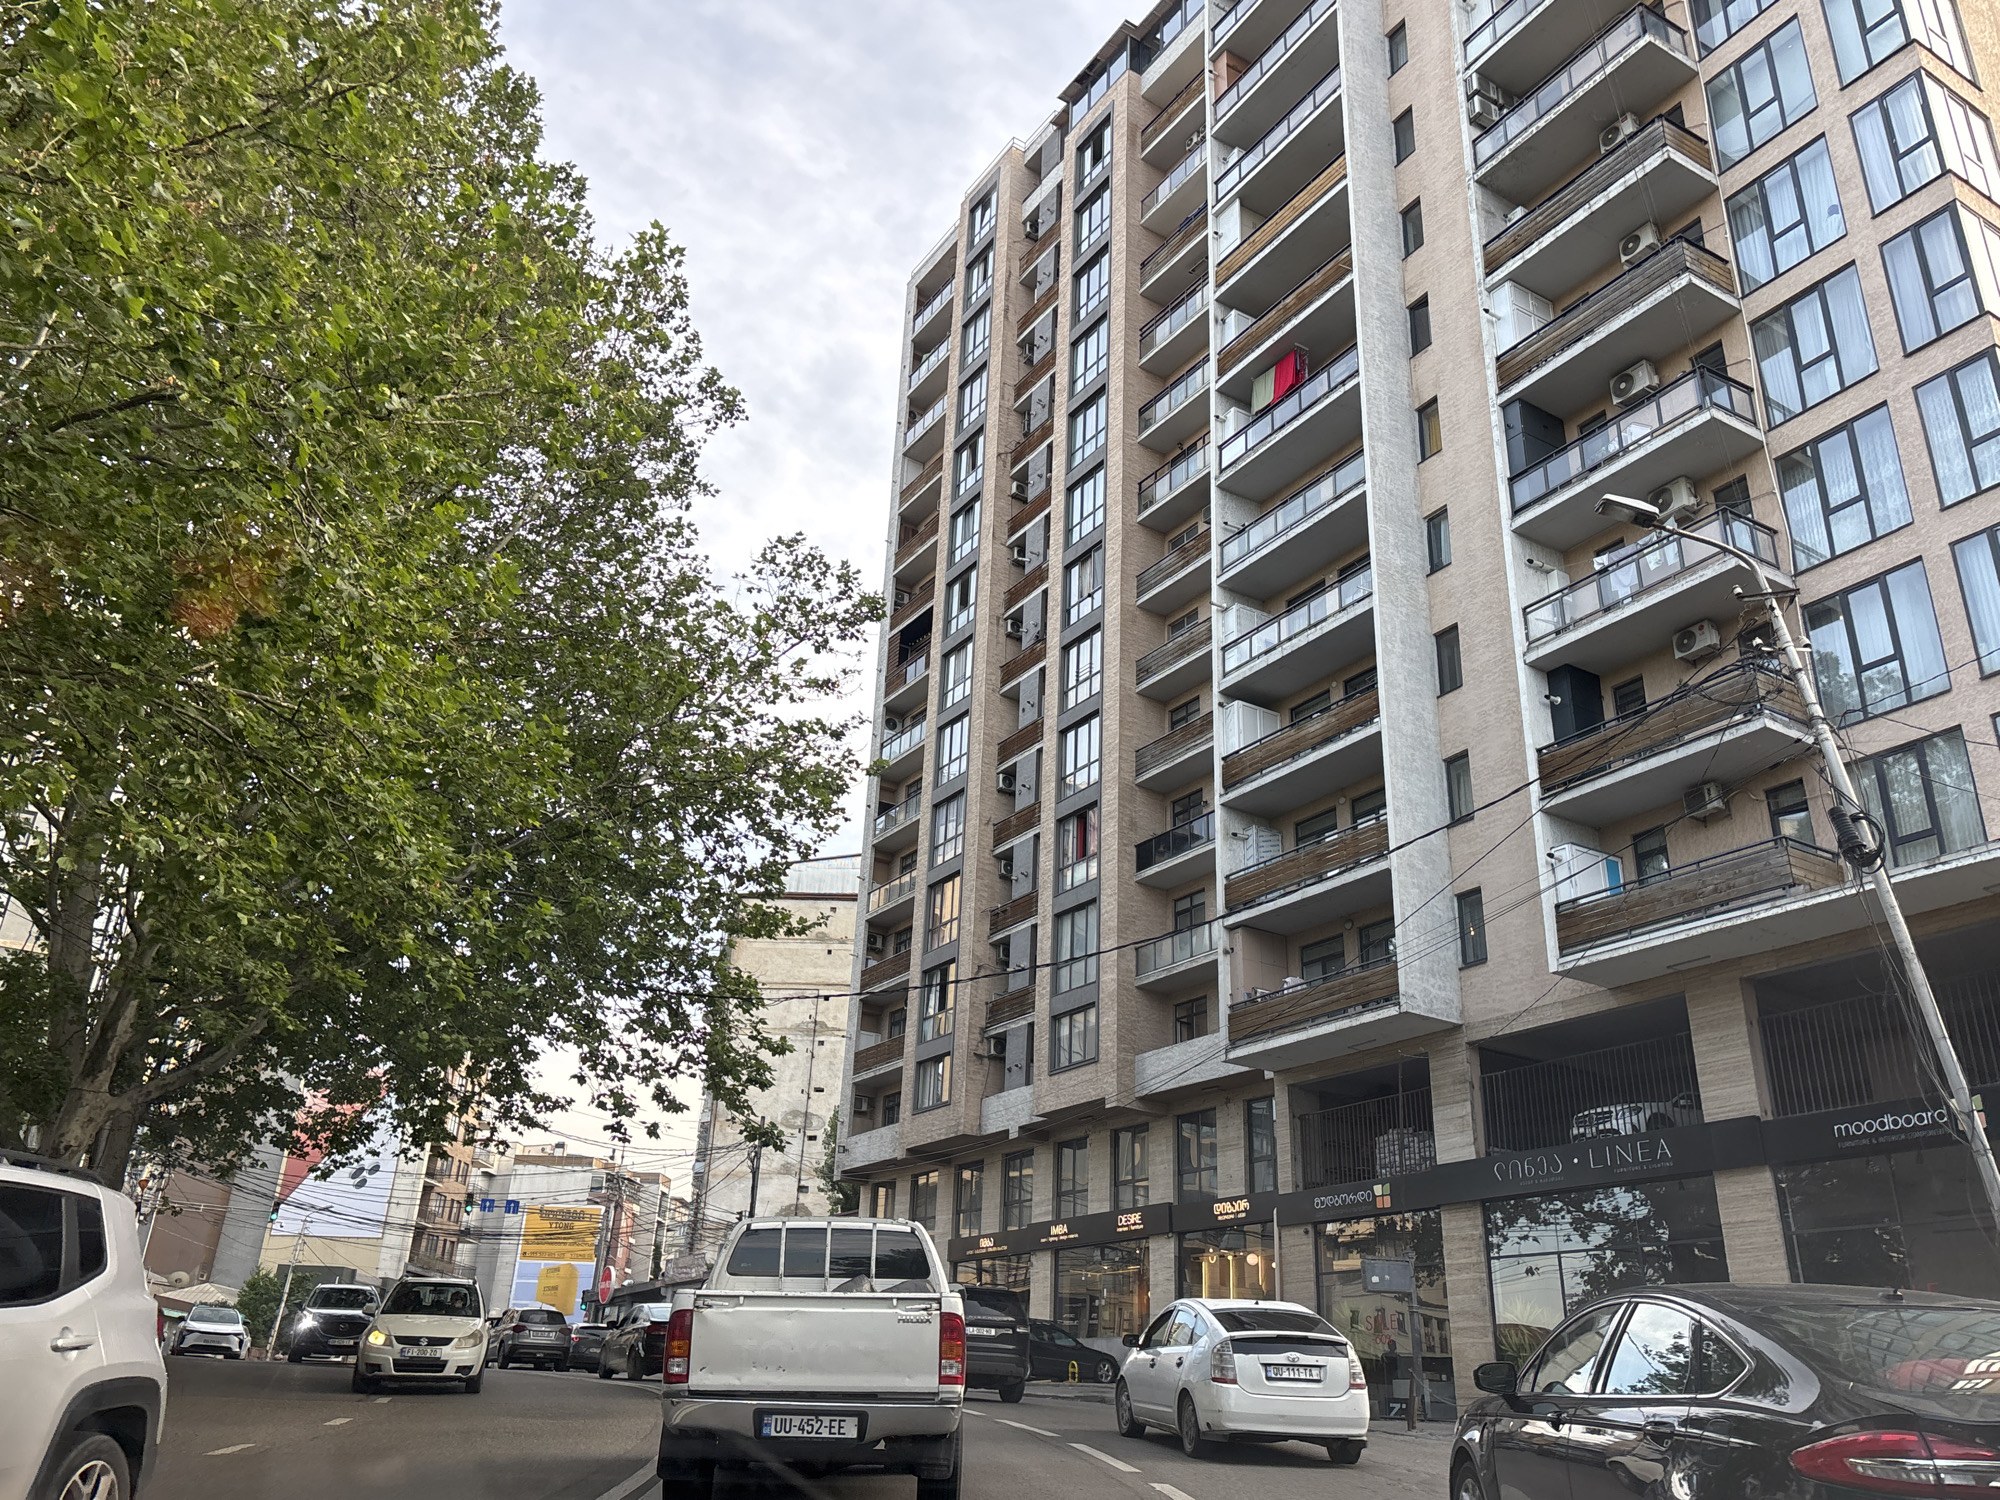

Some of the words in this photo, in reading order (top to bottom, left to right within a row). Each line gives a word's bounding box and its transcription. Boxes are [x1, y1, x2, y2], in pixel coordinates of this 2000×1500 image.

[1833, 1108, 1948, 1138] moodboard
[1588, 1137, 1672, 1169] LINEA
[1493, 1153, 1563, 1182] ლინეა
[1313, 1189, 1373, 1209] მუდბორდი
[548, 1221, 575, 1230] YTONG
[1117, 1212, 1142, 1227] DESIRE
[1050, 1223, 1068, 1236] IMBA
[1365, 1313, 1398, 1332] SALE
[774, 1417, 846, 1436] UU-452-EE
